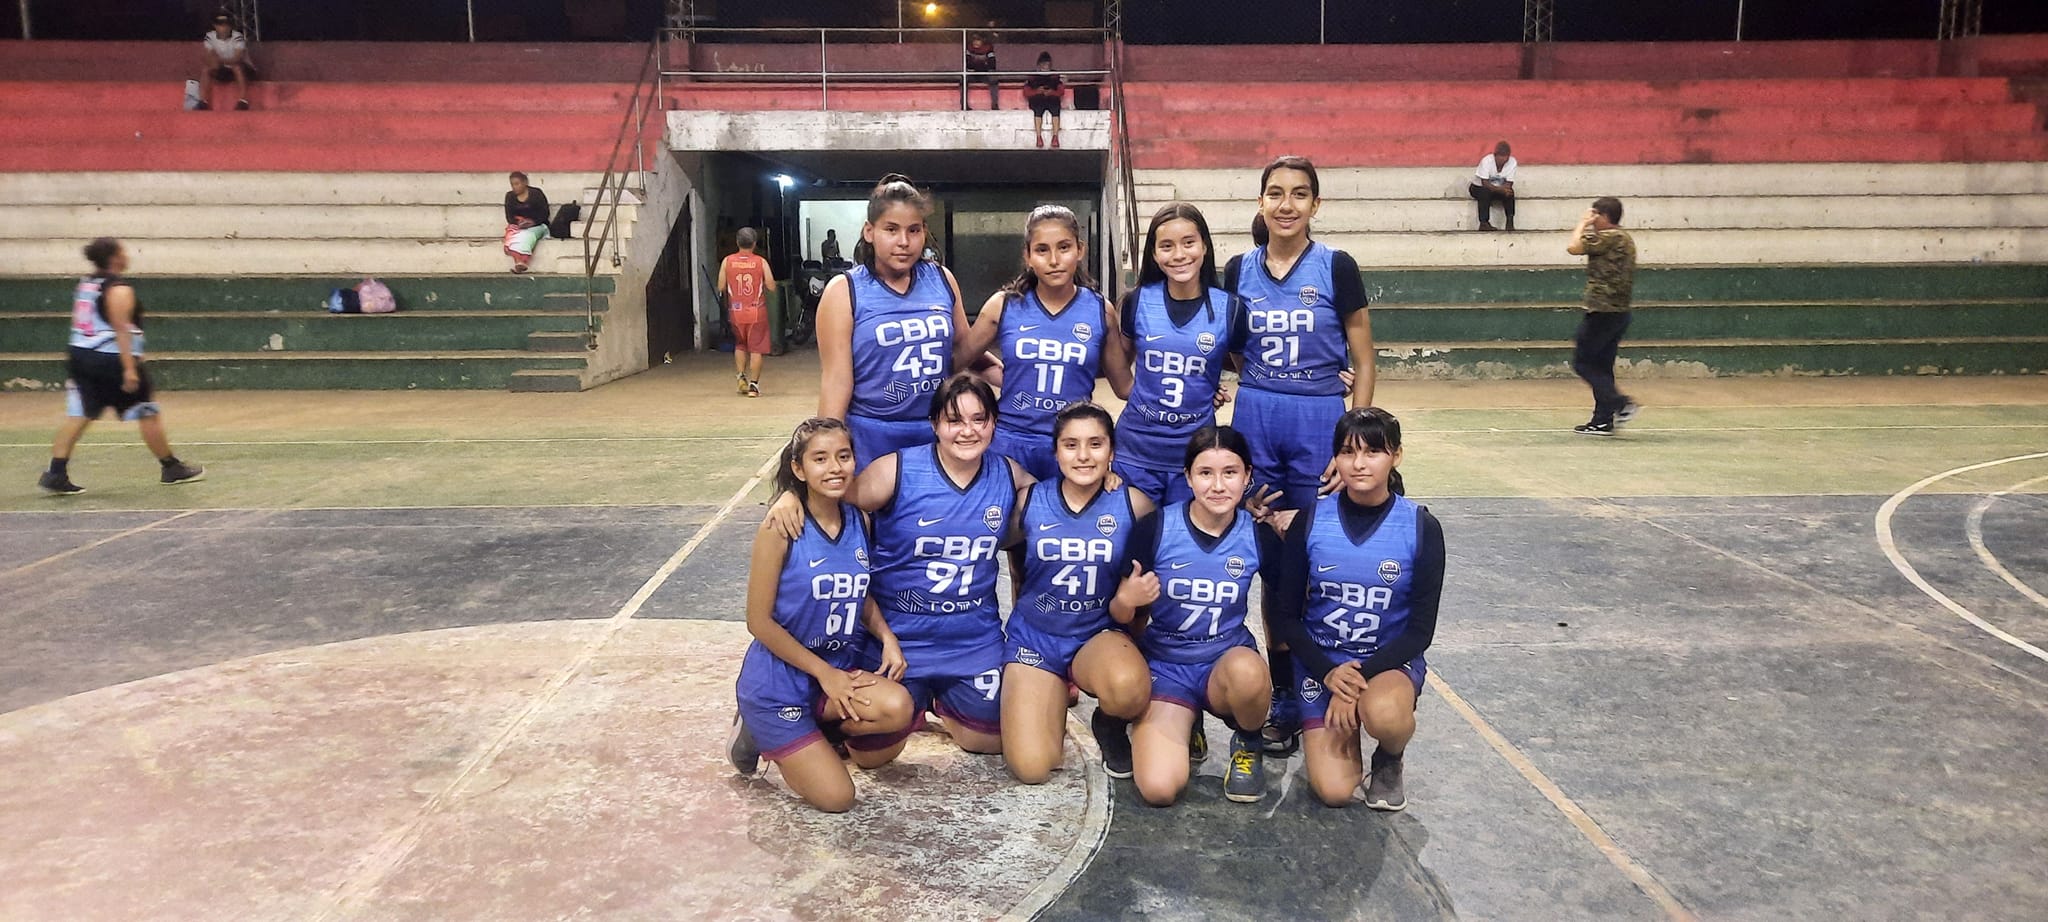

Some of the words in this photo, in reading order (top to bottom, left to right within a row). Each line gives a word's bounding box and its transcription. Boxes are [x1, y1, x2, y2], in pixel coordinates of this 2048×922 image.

[736, 273, 754, 296] 13
[875, 316, 949, 347] CBA
[1248, 310, 1314, 334] CBA
[892, 341, 944, 379] 45
[1016, 338, 1088, 366] CBA
[1144, 350, 1208, 376] CBA
[1260, 336, 1299, 367] 21
[1034, 363, 1065, 395] 11
[1159, 377, 1184, 408] 3
[914, 535, 998, 562] CBA
[1036, 538, 1113, 563] CBA
[811, 573, 870, 601] CBA
[926, 561, 975, 596] 91
[1051, 564, 1098, 596] 41
[1168, 578, 1239, 604] CBA
[1319, 581, 1393, 610] CBA
[825, 602, 858, 636] 61
[1178, 603, 1223, 637] 71
[1323, 608, 1381, 643] 42
[974, 667, 1002, 701] 9
